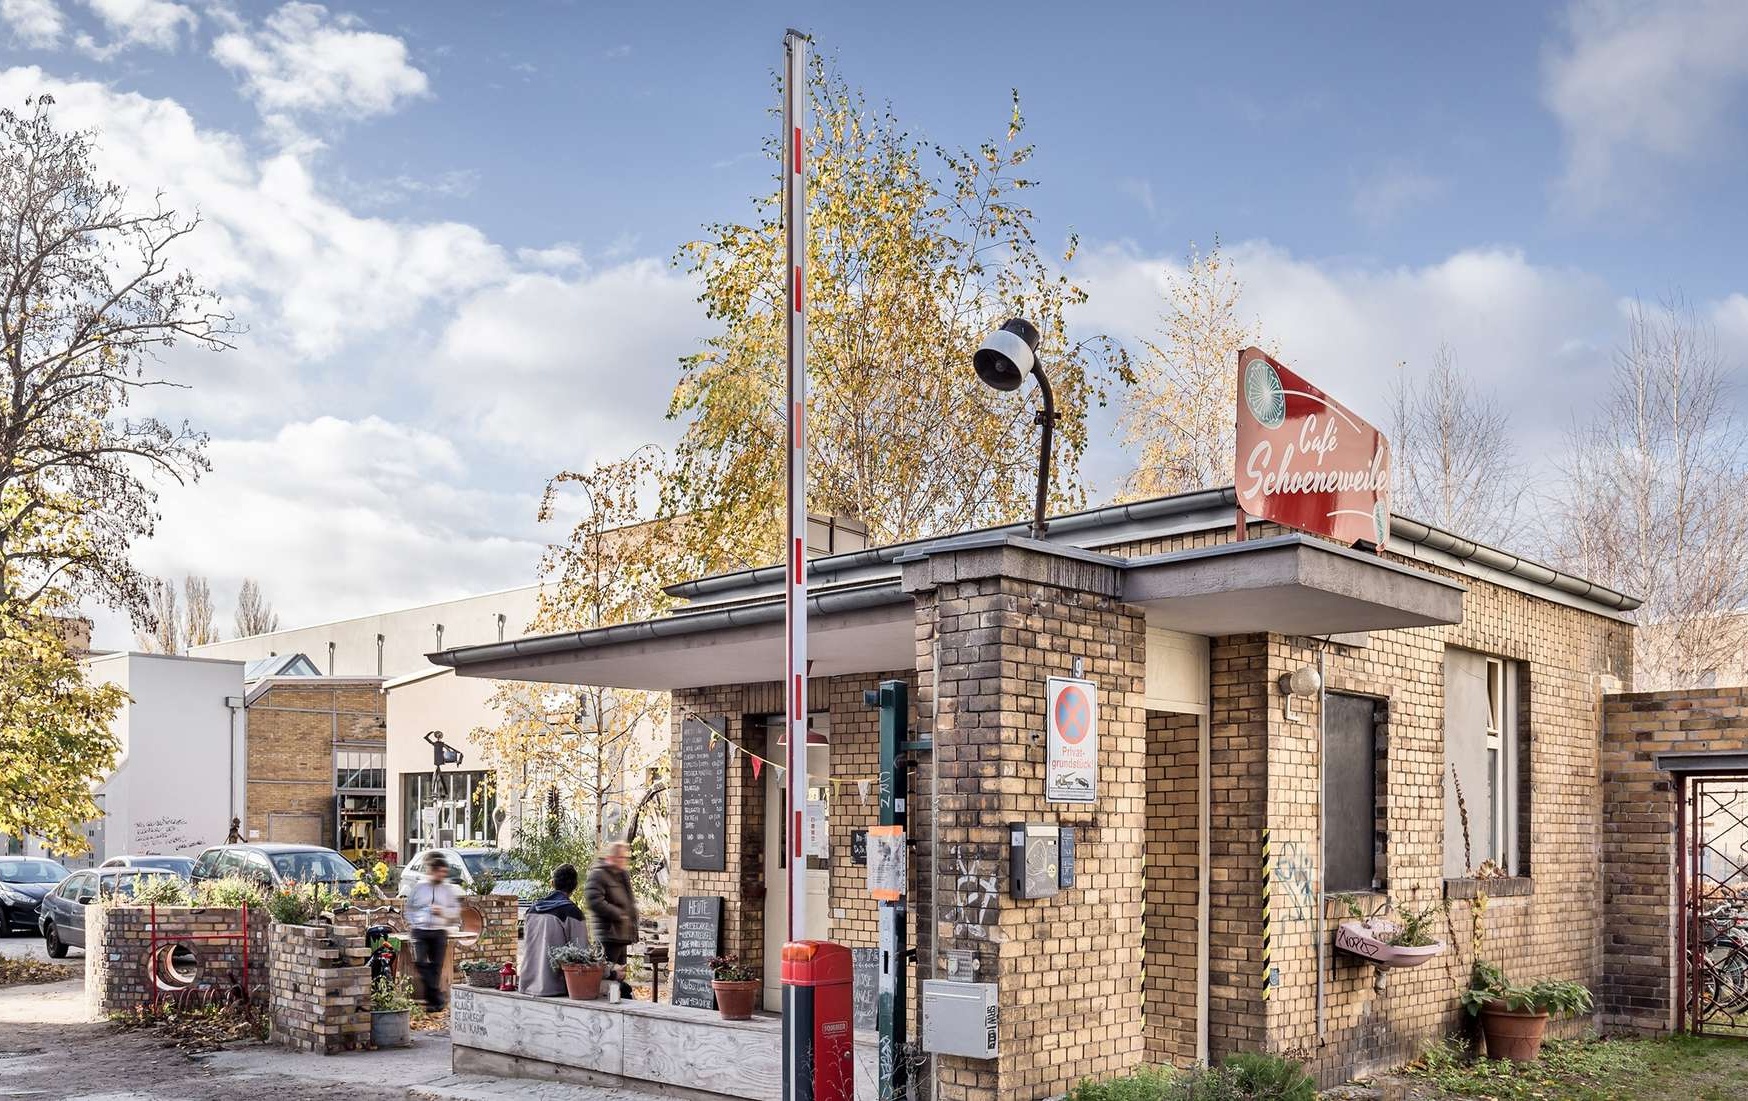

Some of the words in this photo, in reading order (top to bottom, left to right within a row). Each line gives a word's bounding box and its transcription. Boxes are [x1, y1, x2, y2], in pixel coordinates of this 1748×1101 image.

[1299, 413, 1338, 466] Café
[1243, 440, 1387, 500] Schoeneweile
[1074, 659, 1082, 678] 9
[1062, 746, 1085, 757] Privat-
